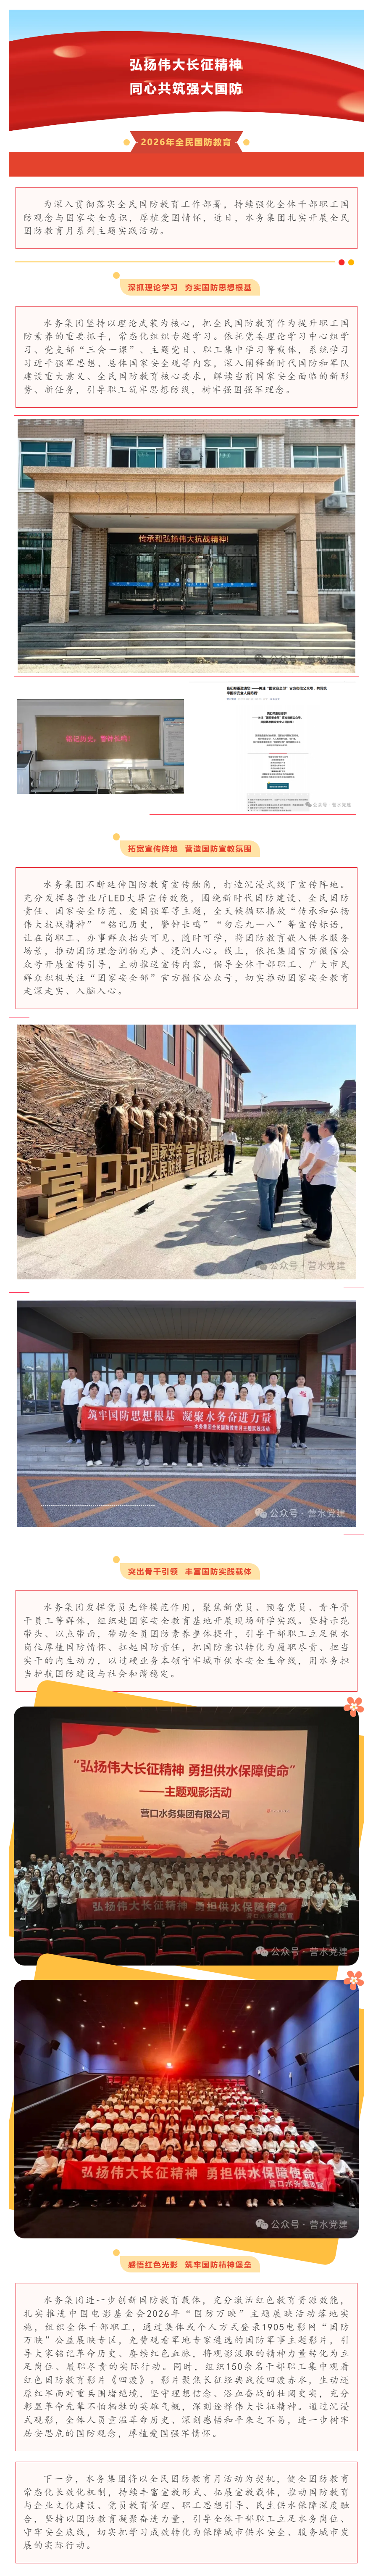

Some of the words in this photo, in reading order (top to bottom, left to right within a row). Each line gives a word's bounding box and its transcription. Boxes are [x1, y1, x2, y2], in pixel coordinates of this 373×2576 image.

[129, 58, 242, 71] 弘扬伟大长征精神
[130, 82, 242, 95] 同心共筑强大国防
[141, 137, 231, 147] 2026年全民国防教育
[24, 986, 123, 995] 走深走实、入脑入心。
[148, 1141, 182, 1161] 国家安全
[149, 1158, 182, 1182] 人民防线
[31, 1147, 150, 1219] 营口市
[87, 1409, 175, 1422] 筑牢国防思想根基
[182, 1411, 272, 1424] 凝聚水务奋进力量
[74, 1760, 185, 1776] “弘扬伟大长征精神
[188, 1764, 295, 1778] 勇担供水保障使命”
[139, 1786, 232, 1798] ——主题观影活动
[140, 1808, 230, 1819] 营口水务集团有限公司
[92, 1900, 188, 1912] 弘扬伟大长征精神
[195, 1901, 287, 1913] 勇担供水保障使命
[82, 2166, 198, 2180] 弘扬伟大长征精神
[207, 2166, 315, 2180] 勇担供水保障使命
[268, 2180, 324, 2190] 营口水务集团宣
[23, 2541, 91, 2550] 展的实际行动。
